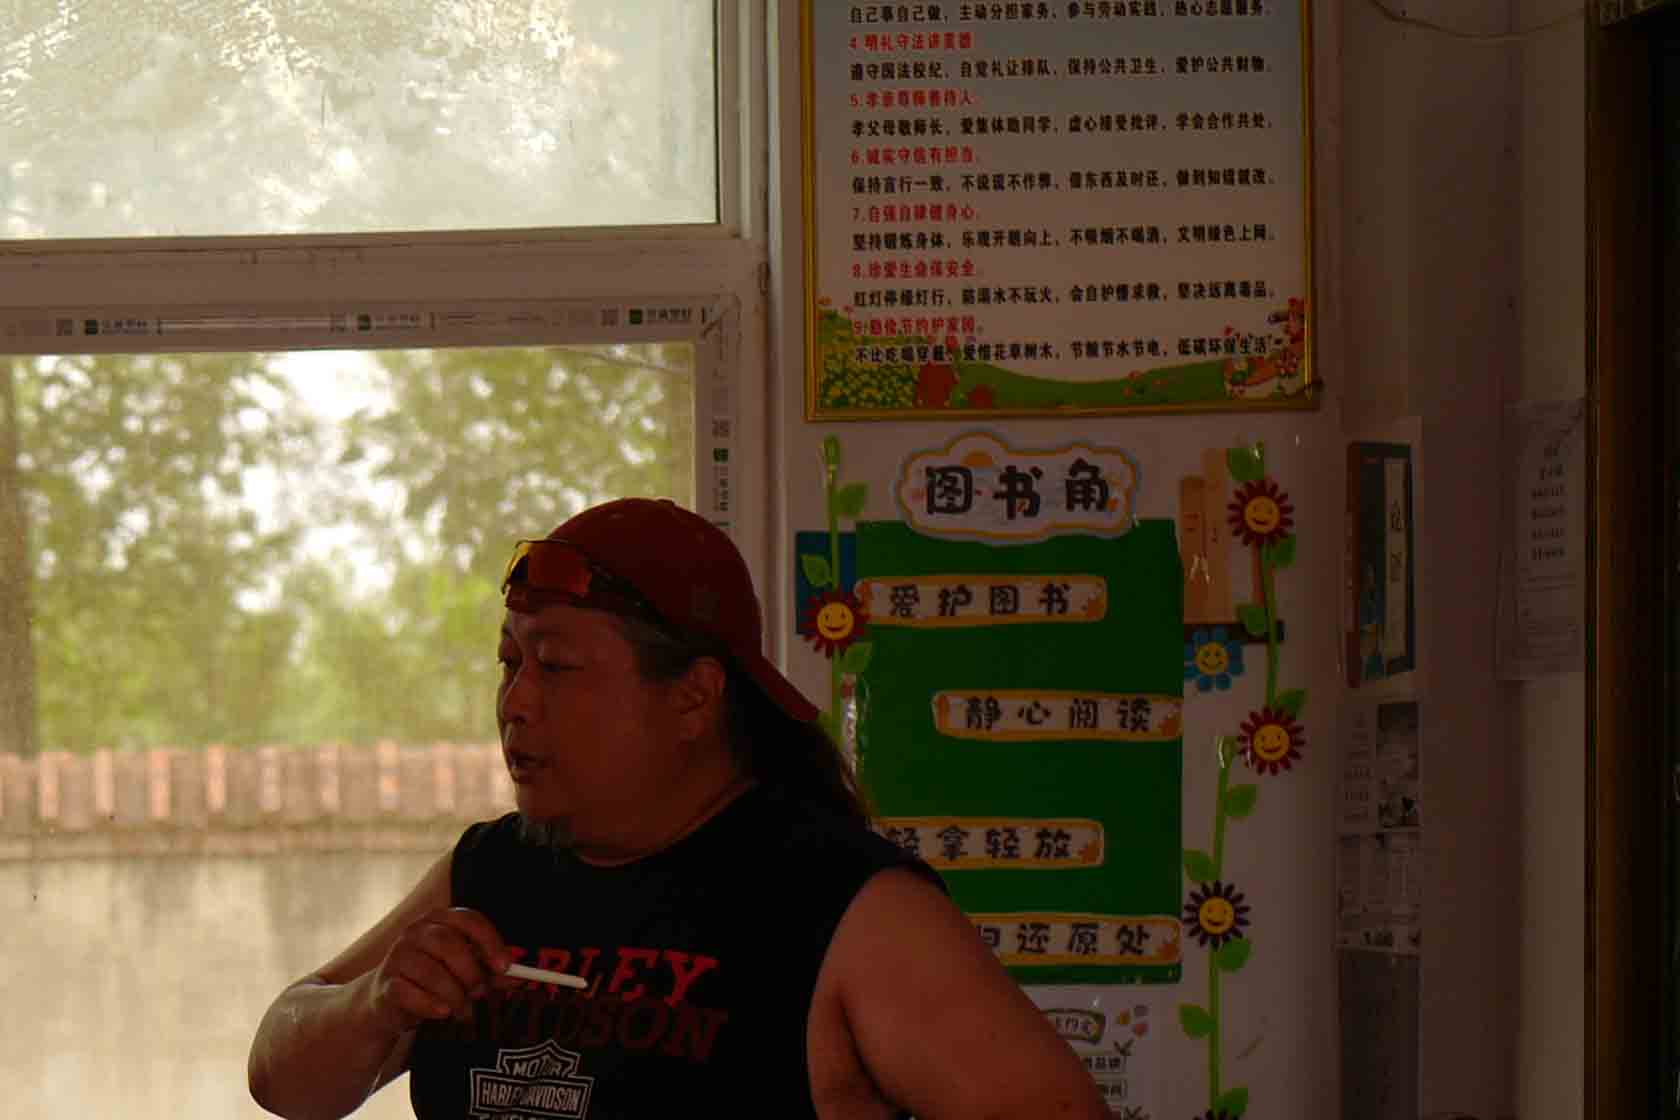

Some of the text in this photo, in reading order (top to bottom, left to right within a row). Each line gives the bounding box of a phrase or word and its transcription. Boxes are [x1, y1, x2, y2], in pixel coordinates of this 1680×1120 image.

[926, 460, 1109, 518] 图书角
[889, 583, 1071, 618] 爱护图书
[965, 698, 1153, 732] 静心阅读
[884, 826, 1072, 861] 轻拿轻放
